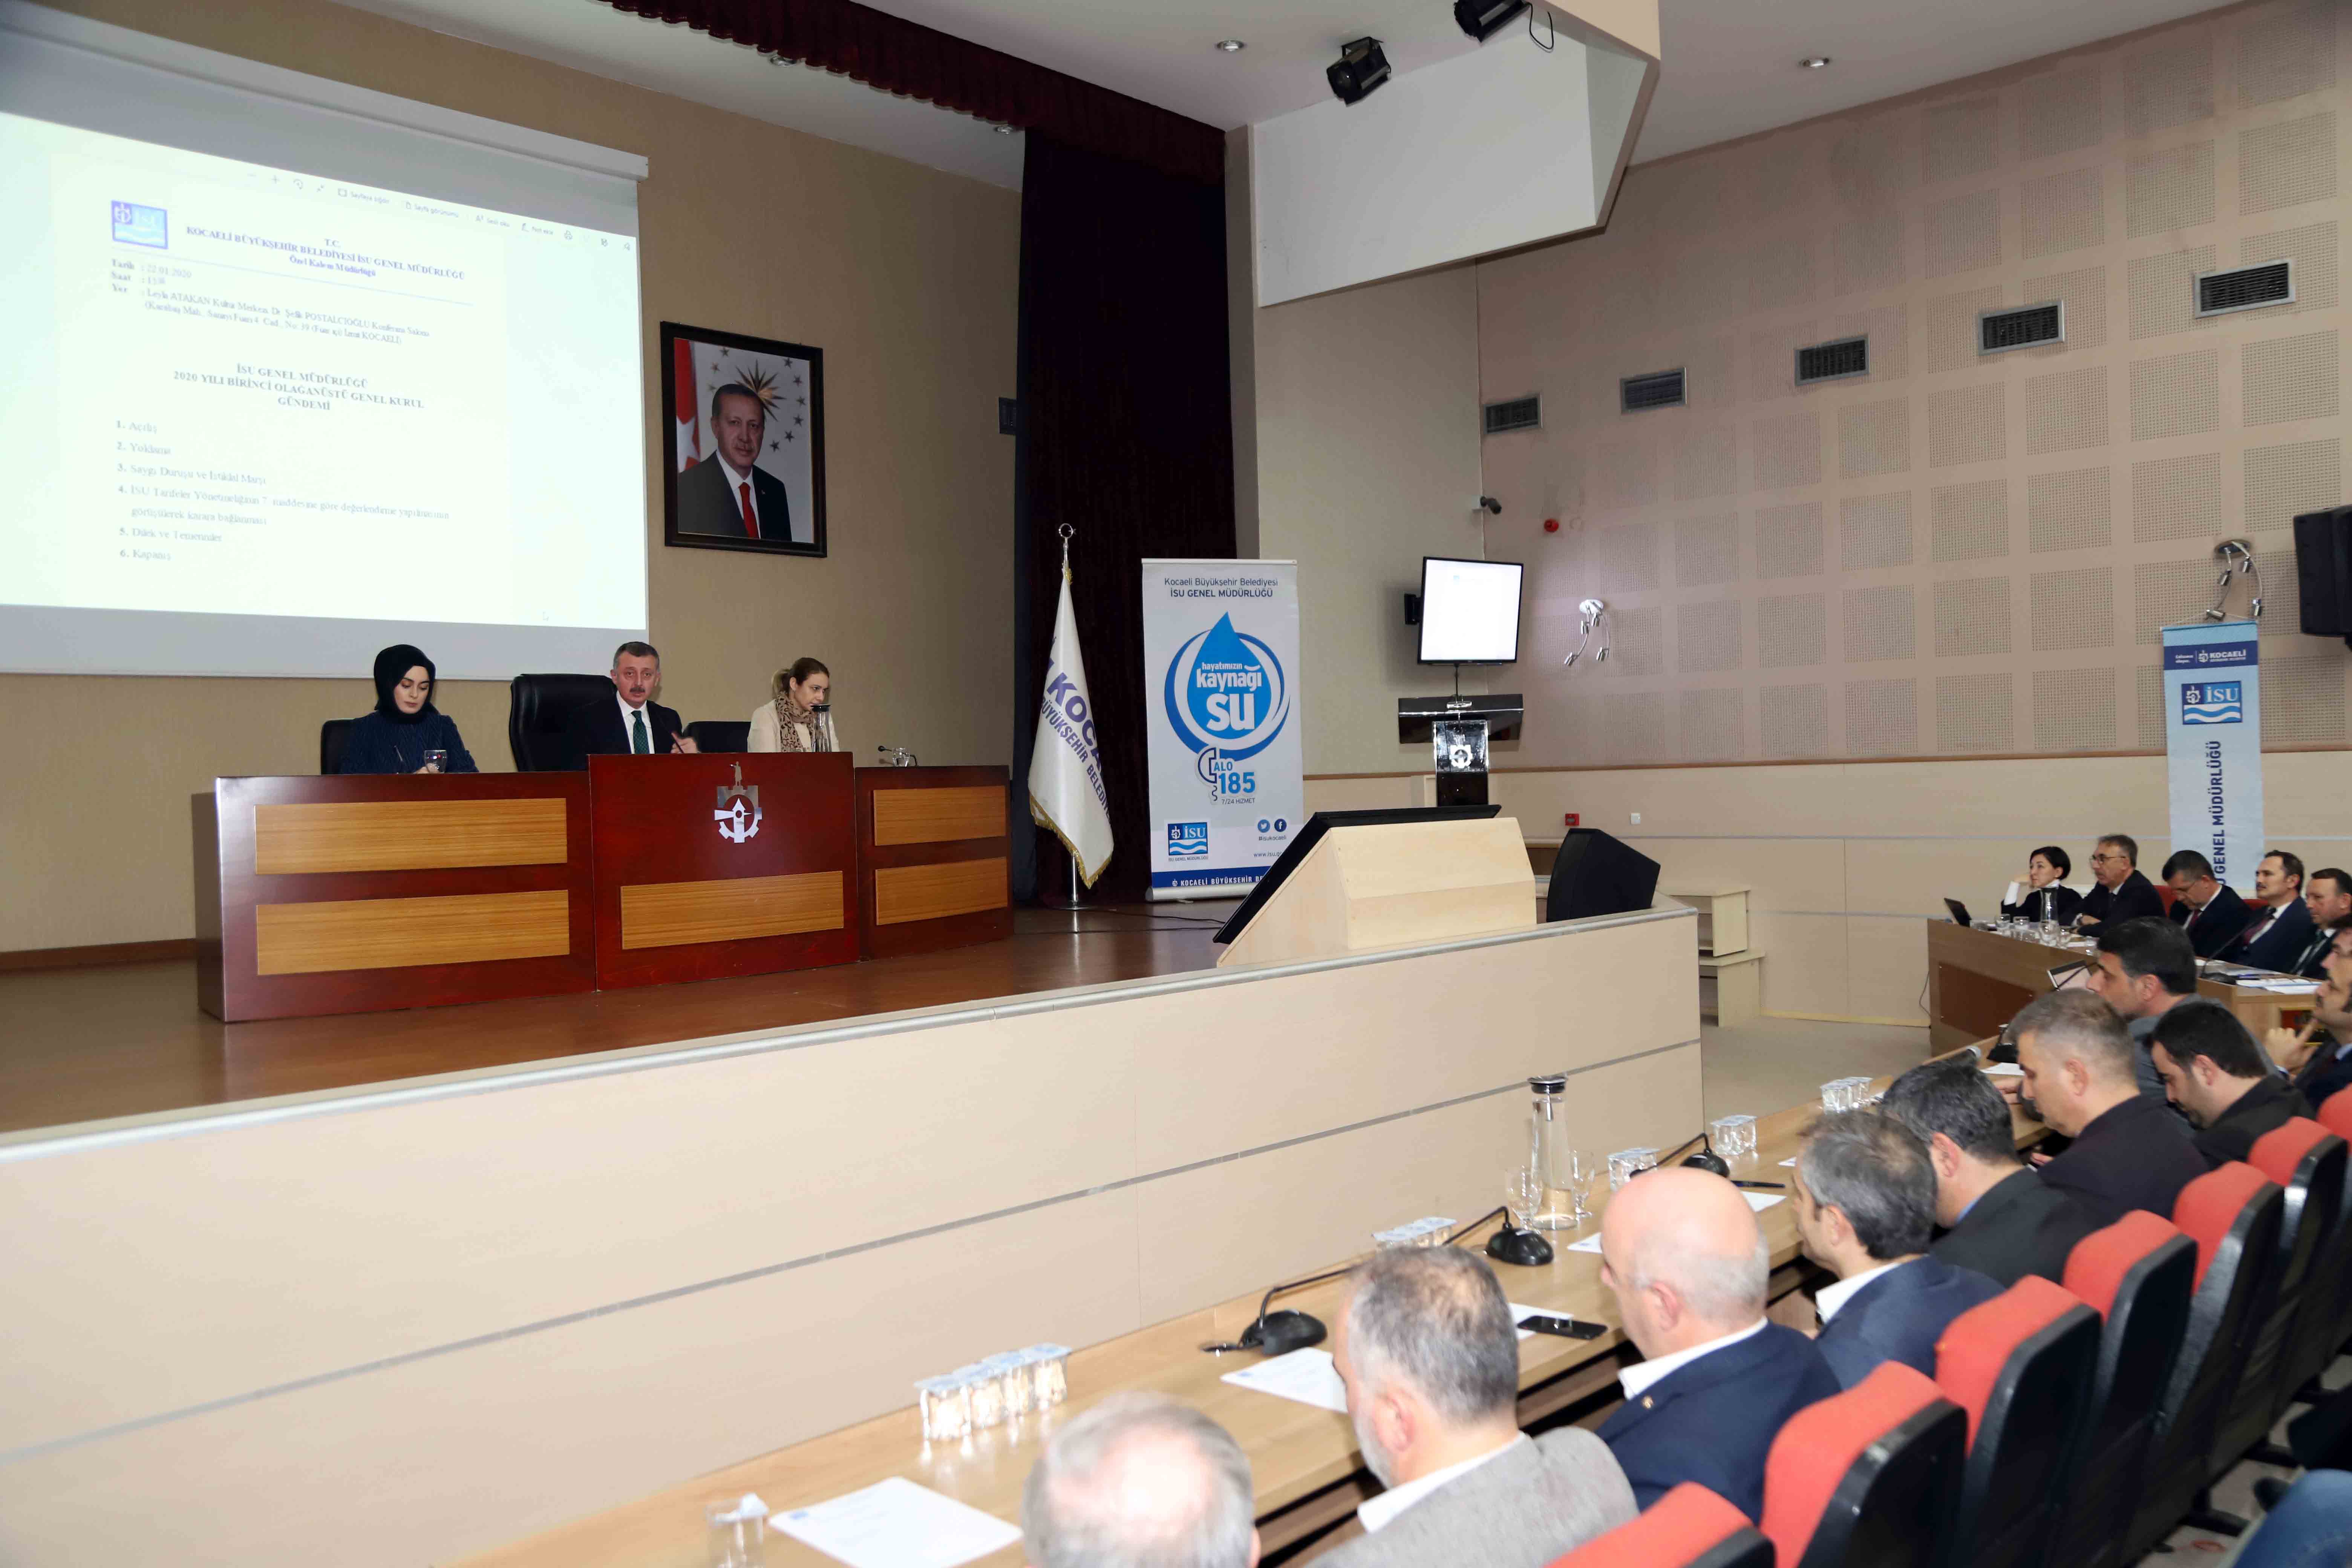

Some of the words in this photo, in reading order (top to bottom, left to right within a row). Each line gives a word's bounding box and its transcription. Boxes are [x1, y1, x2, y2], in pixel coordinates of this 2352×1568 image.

[325, 238, 341, 248] T.C.
[187, 226, 232, 241] KOCAELİ
[234, 233, 299, 253] BÜYÜKŞEHİR
[301, 246, 355, 262] BELEDİYESİ
[357, 254, 372, 264] İSU
[374, 257, 405, 271] GENEL
[407, 262, 465, 280] MÜDÜRLÜĞÜ
[112, 258, 135, 270] Tarih
[289, 254, 307, 266] Özel
[309, 257, 334, 270] Kalem
[336, 262, 376, 277] Müdürlüğü
[112, 271, 131, 281] Saat
[112, 283, 129, 293] Yer
[170, 292, 211, 305] ATAKAN
[237, 363, 256, 375] İSU
[258, 367, 296, 381] GENEL
[299, 371, 368, 389] MÜDÜRLÜĞÜ
[174, 370, 198, 382] 2020
[201, 374, 225, 385] YILI
[227, 376, 272, 390] BİRİNCİ
[274, 381, 348, 400] OLAĞANÜSTÜ
[350, 392, 387, 404] GENEL
[389, 397, 425, 409] KURUL
[277, 396, 331, 411] GÜNDEMİ
[129, 422, 157, 434] Açılış
[130, 443, 171, 455] Yoklama
[130, 465, 157, 476] Saygı
[160, 467, 193, 479] Duruşu
[320, 502, 338, 511] göre
[187, 512, 215, 522] karara
[132, 549, 171, 561] Kapanış
[1164, 578, 1193, 586] Kocaeli
[1195, 578, 1237, 588] Büyükşehir
[1240, 578, 1279, 587] Belediyesi
[1170, 588, 1185, 597] İSU
[1219, 588, 1273, 597] MÜDÜRLÜĞÜ
[1202, 662, 1243, 672] hayatımızın
[1196, 665, 1263, 692] kaynağı
[2207, 686, 2239, 702] İSU
[1214, 761, 1233, 771] ALO
[1218, 772, 1256, 794] 185
[2205, 741, 2224, 825] MÜDÜRLÜĞÜ
[1184, 825, 1206, 839] İSU
[2213, 829, 2226, 875] GENEL
[1181, 877, 1208, 887] KOCAELİ
